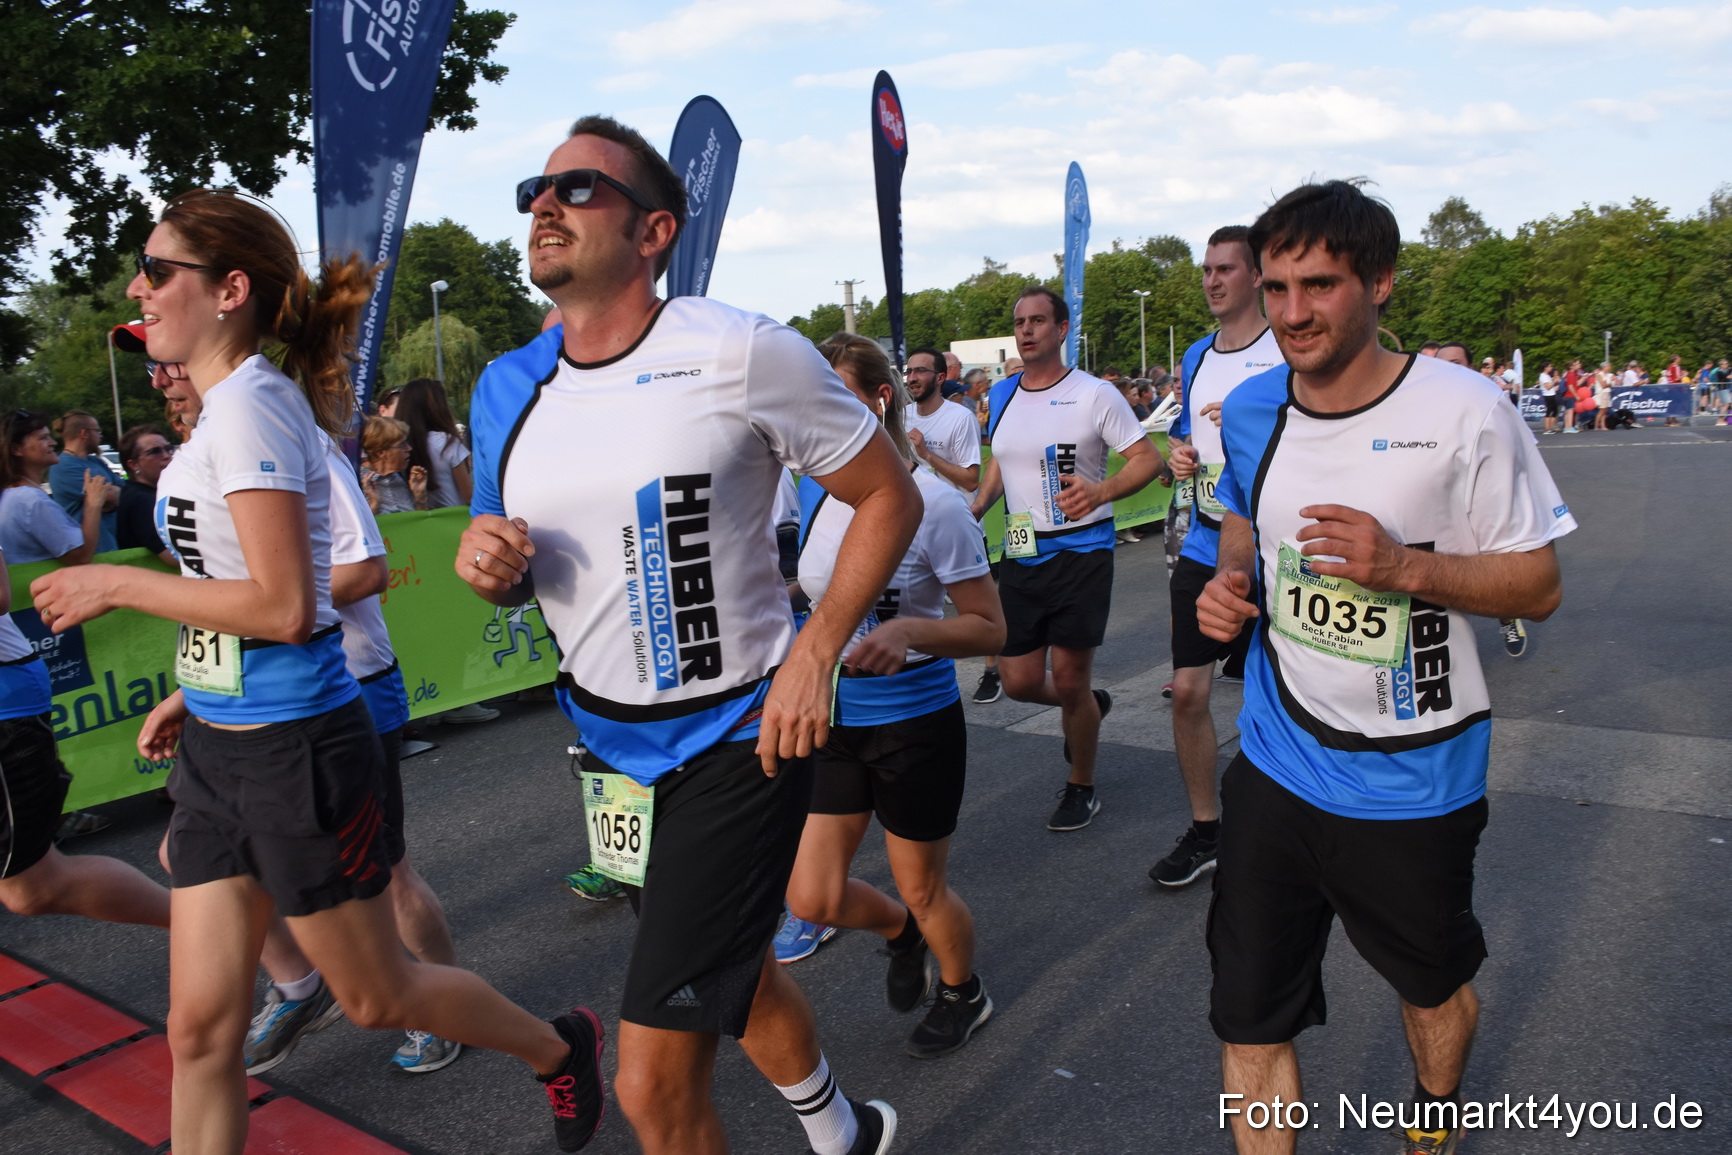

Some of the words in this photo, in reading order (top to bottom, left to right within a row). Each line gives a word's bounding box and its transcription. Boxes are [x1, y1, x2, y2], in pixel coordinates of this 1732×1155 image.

[691, 128, 718, 204] Fischer
[1620, 399, 1672, 410] Fischer
[622, 525, 637, 575] WASTE
[643, 522, 675, 681] TECHNOLOGY
[664, 473, 722, 686] HUBER
[1373, 596, 1400, 607] 2019
[626, 579, 642, 627] WATER
[1287, 585, 1388, 639] 1035
[1301, 622, 1325, 638] Beck
[1328, 631, 1364, 647] Fabian
[1312, 635, 1337, 648] HUBER
[1338, 643, 1349, 651] SE
[632, 630, 649, 684] Solutions
[1375, 671, 1388, 715] Solutions
[592, 810, 641, 853] 1058
[616, 853, 640, 867] Thomas
[667, 998, 702, 1006] adidas
